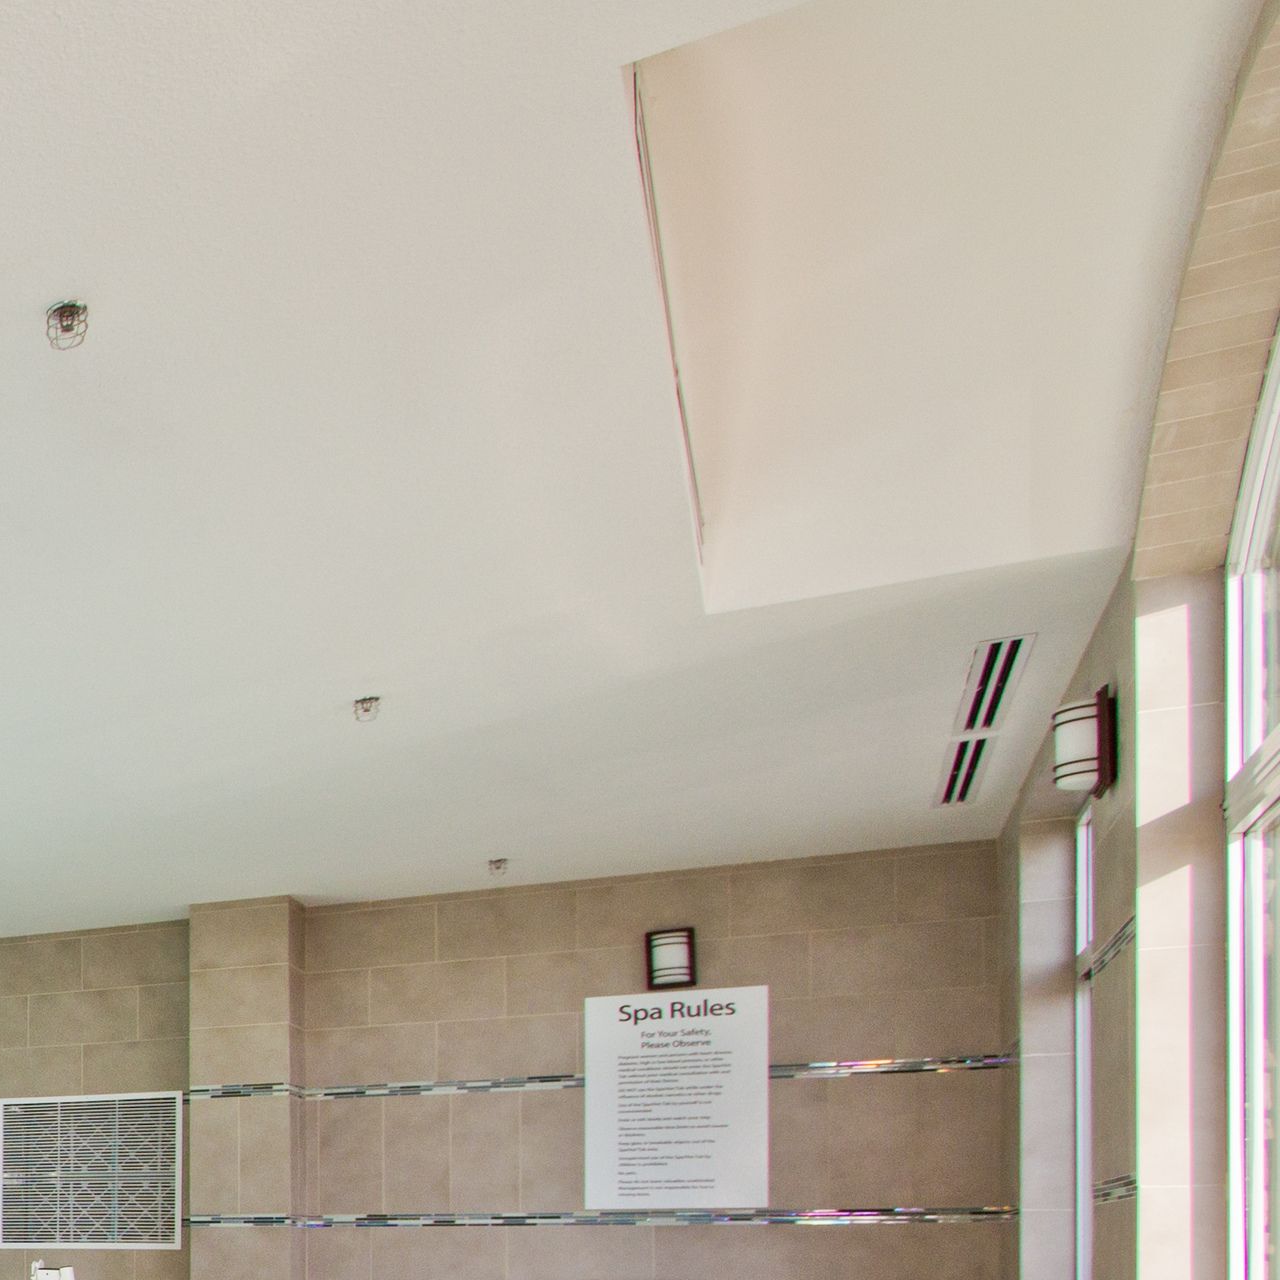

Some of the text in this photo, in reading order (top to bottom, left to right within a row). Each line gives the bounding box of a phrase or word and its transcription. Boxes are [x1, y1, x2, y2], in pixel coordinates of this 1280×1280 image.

[618, 999, 736, 1025] Spa Rules
[641, 1030, 655, 1038] For
[657, 1030, 678, 1038] Your
[640, 1039, 711, 1049] Please Observe
